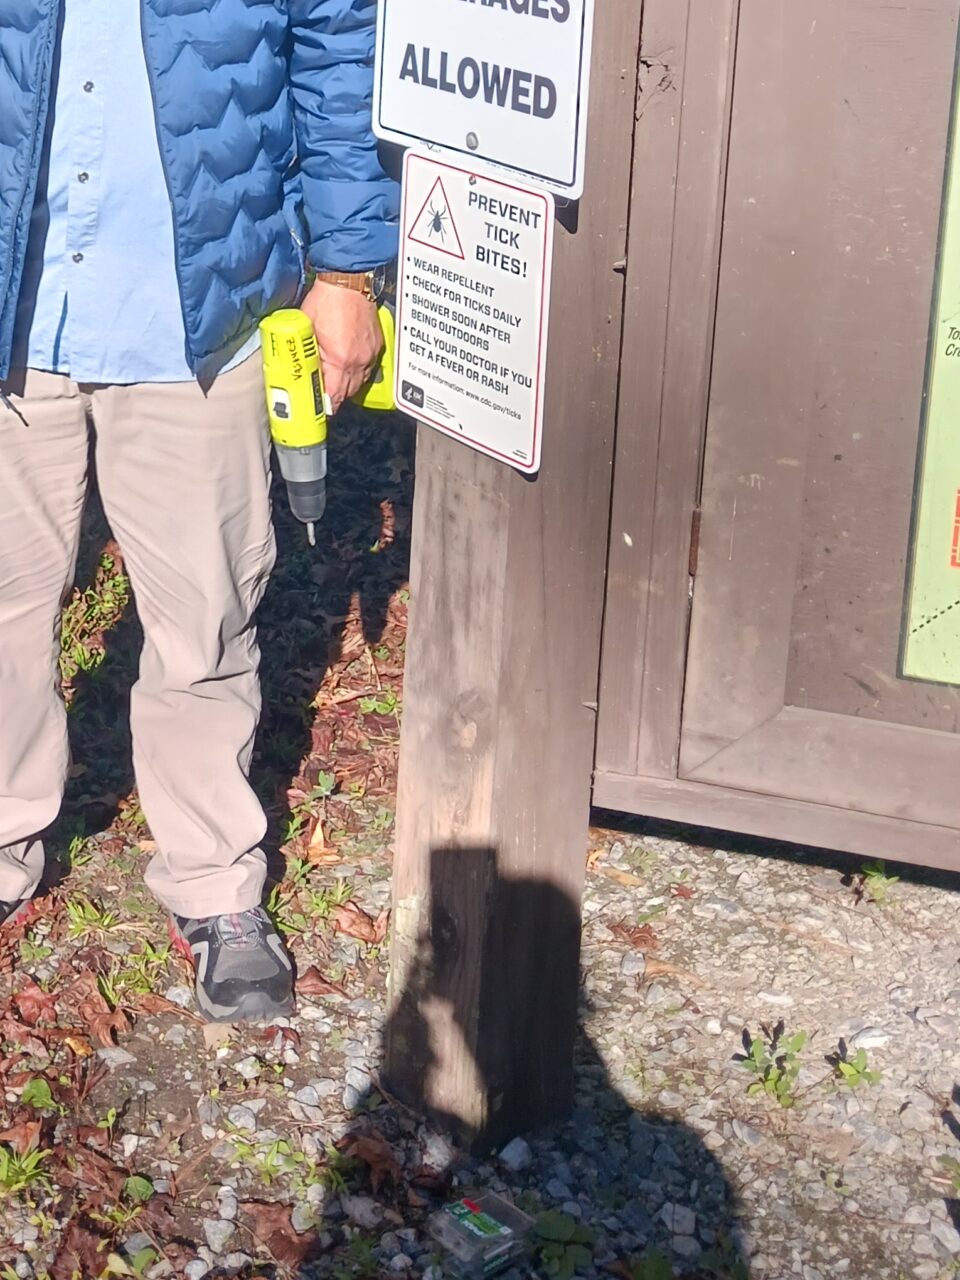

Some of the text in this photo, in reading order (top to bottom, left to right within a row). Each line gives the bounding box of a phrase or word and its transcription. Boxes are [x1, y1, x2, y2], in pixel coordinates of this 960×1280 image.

[399, 43, 558, 120] ALLOWED
[469, 191, 541, 229] PREVENT
[484, 221, 520, 249] TICK
[413, 257, 495, 297] WEAR REPELLENT
[476, 244, 527, 278] BITES!
[412, 275, 522, 328] CHECK FOR TICKS DAILY
[412, 293, 511, 344] SHOWER SOON AFTER
[411, 309, 490, 351] BEING OUTDOORS
[948, 327, 960, 340] To
[409, 342, 509, 396] GET A FEVER OR RASH
[410, 327, 533, 388] CALL YOUR DOCTOR IF YOU
[408, 362, 417, 371] For
[418, 368, 431, 379] more
[465, 390, 522, 420] www.cdc.gov/ticks
